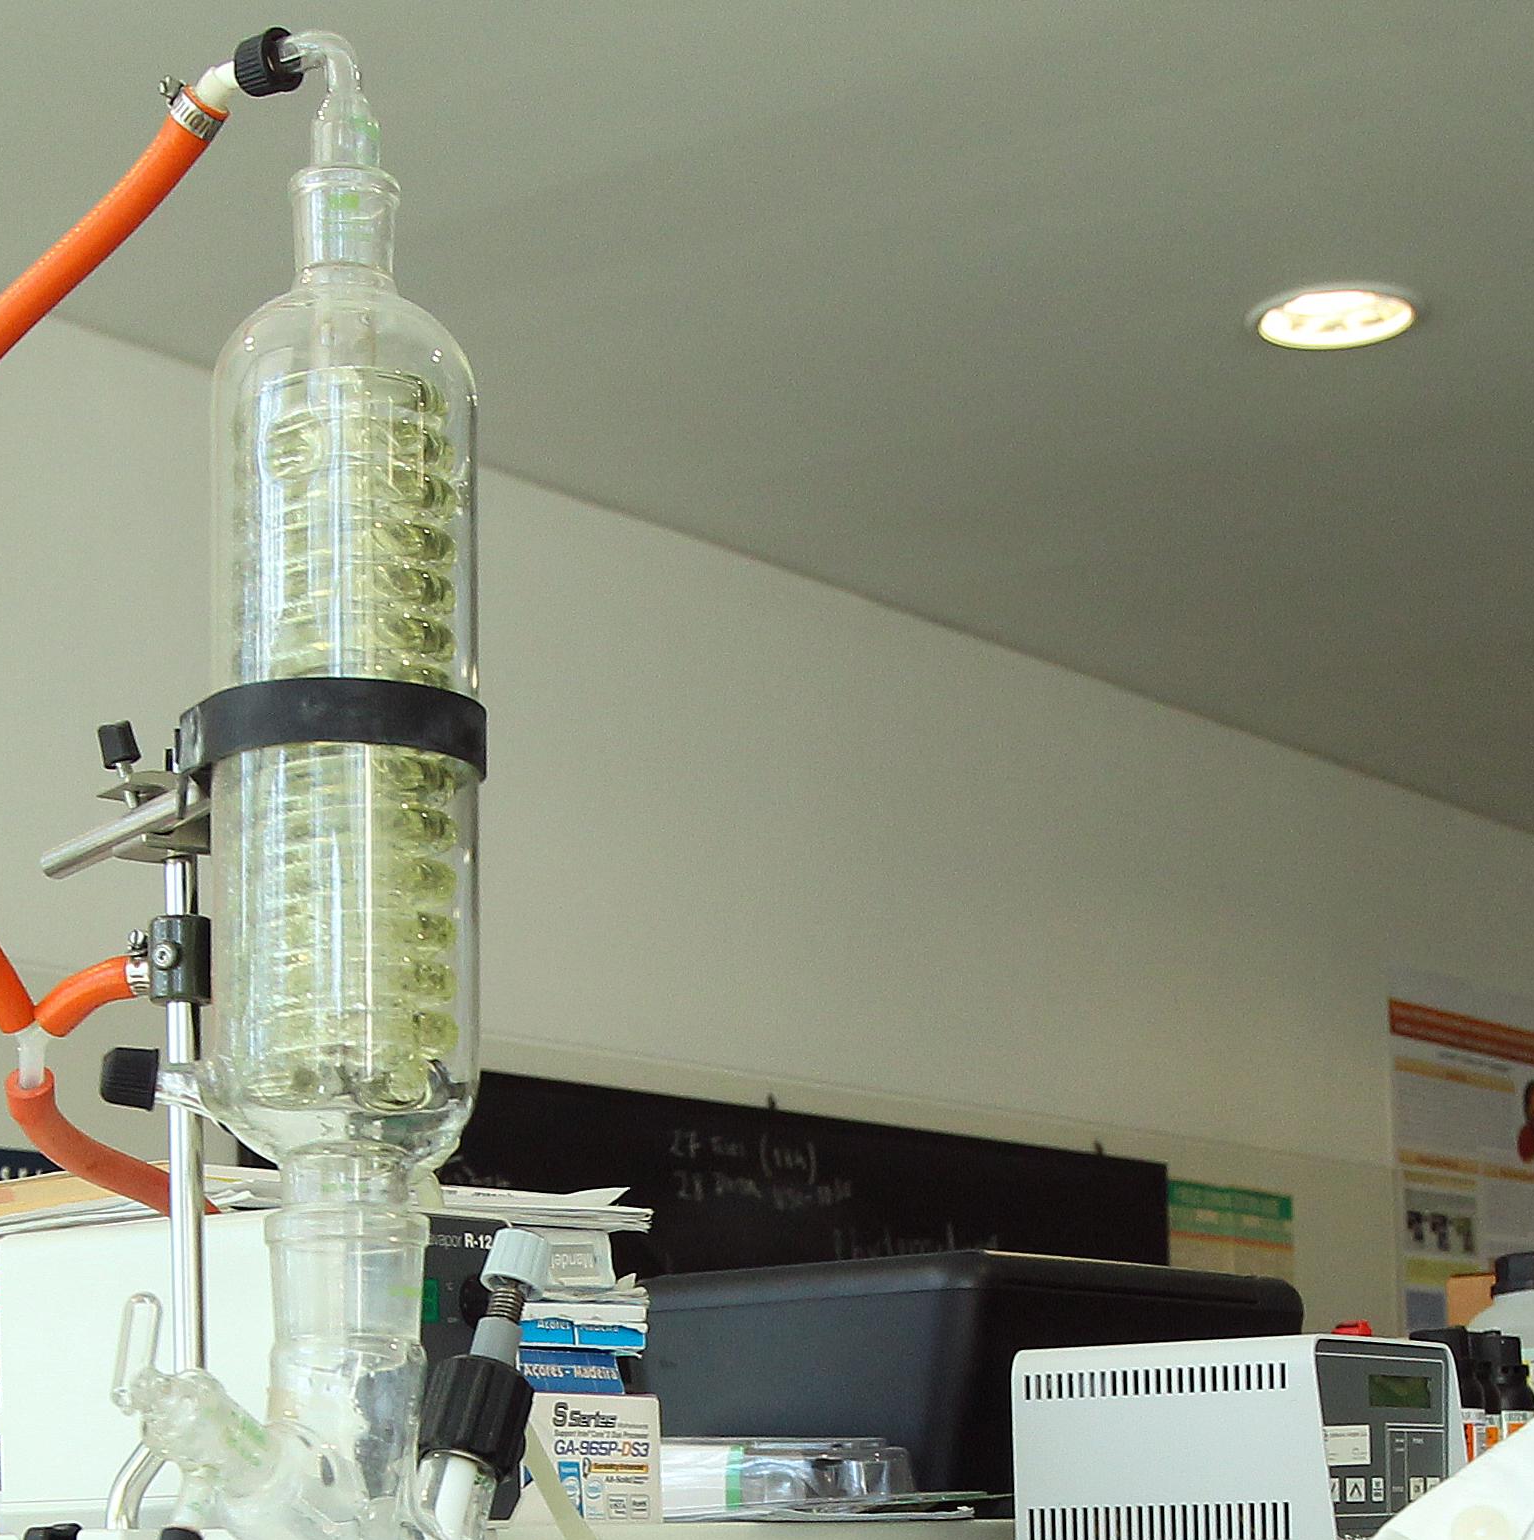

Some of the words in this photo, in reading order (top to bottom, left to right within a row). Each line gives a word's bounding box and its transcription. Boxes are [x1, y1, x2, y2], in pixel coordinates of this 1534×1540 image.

[524, 1365, 564, 1380] Açores
[573, 1365, 619, 1379] Madeira
[553, 1401, 569, 1427] S
[568, 1410, 618, 1428] Series
[554, 1439, 650, 1458] GA-965P-DS3
